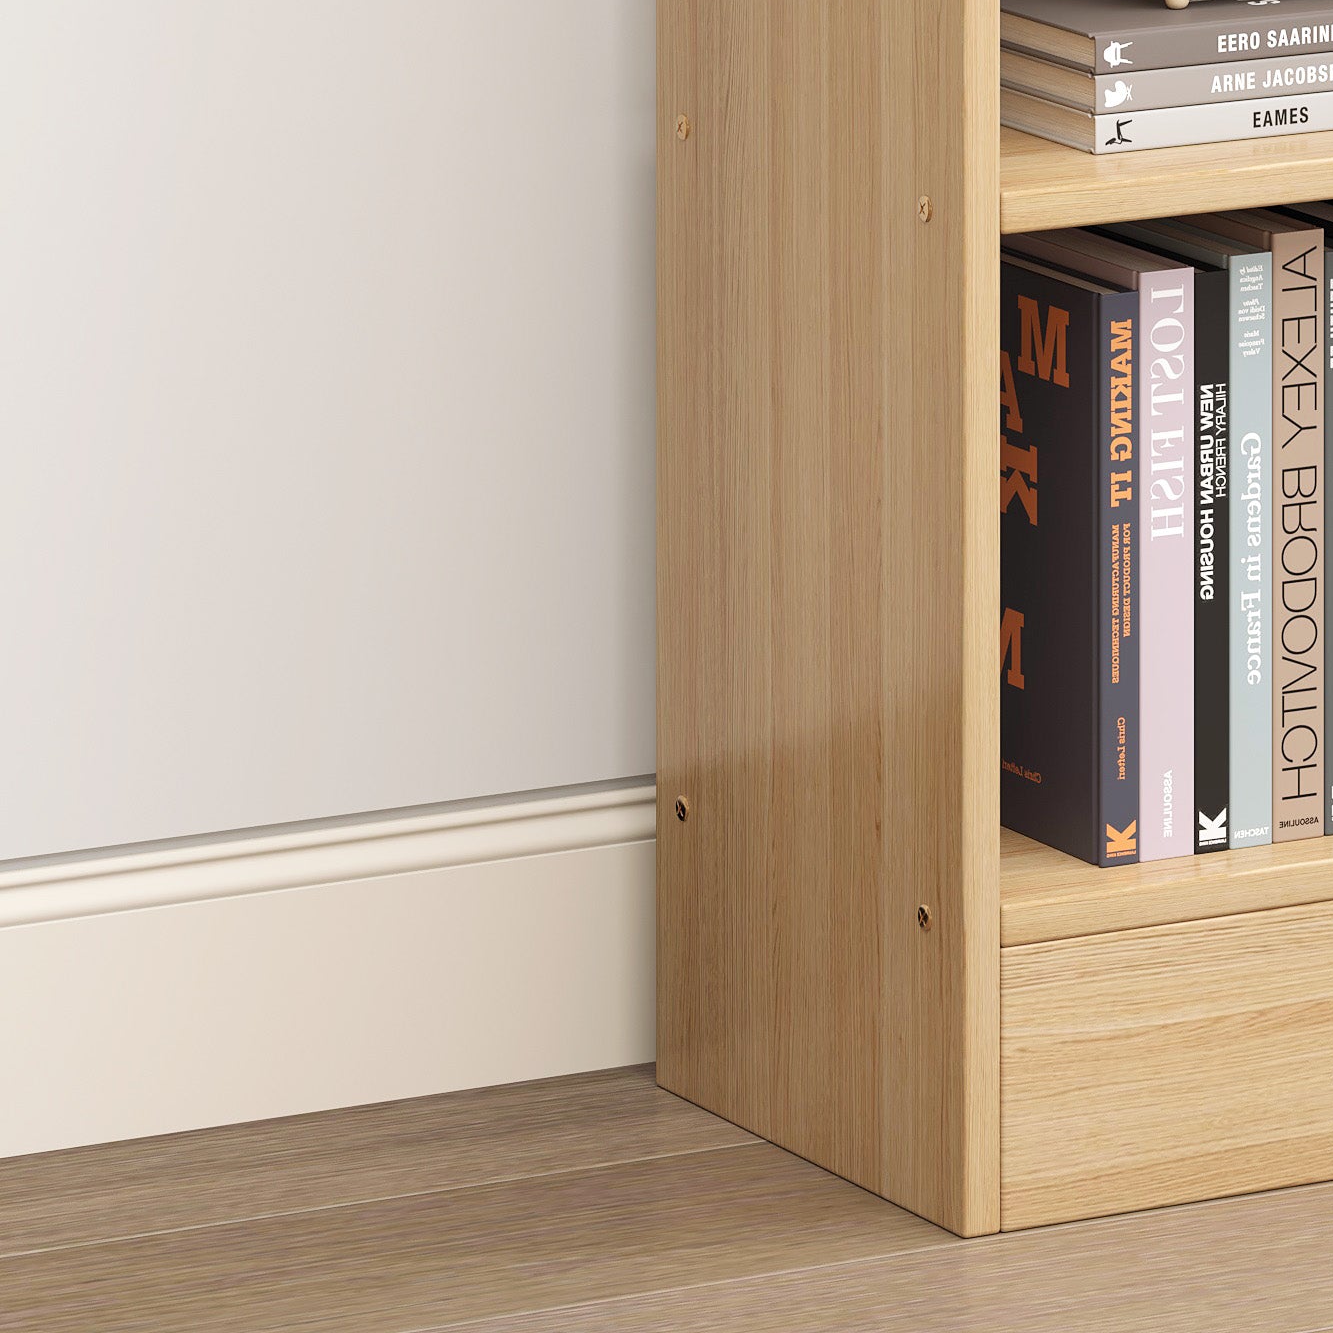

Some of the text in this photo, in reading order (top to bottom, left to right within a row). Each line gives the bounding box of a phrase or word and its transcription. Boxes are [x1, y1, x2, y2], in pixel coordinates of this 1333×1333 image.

[1217, 31, 1260, 53] EERO
[1211, 71, 1256, 93] ARNE
[1253, 106, 1309, 128] EAMES
